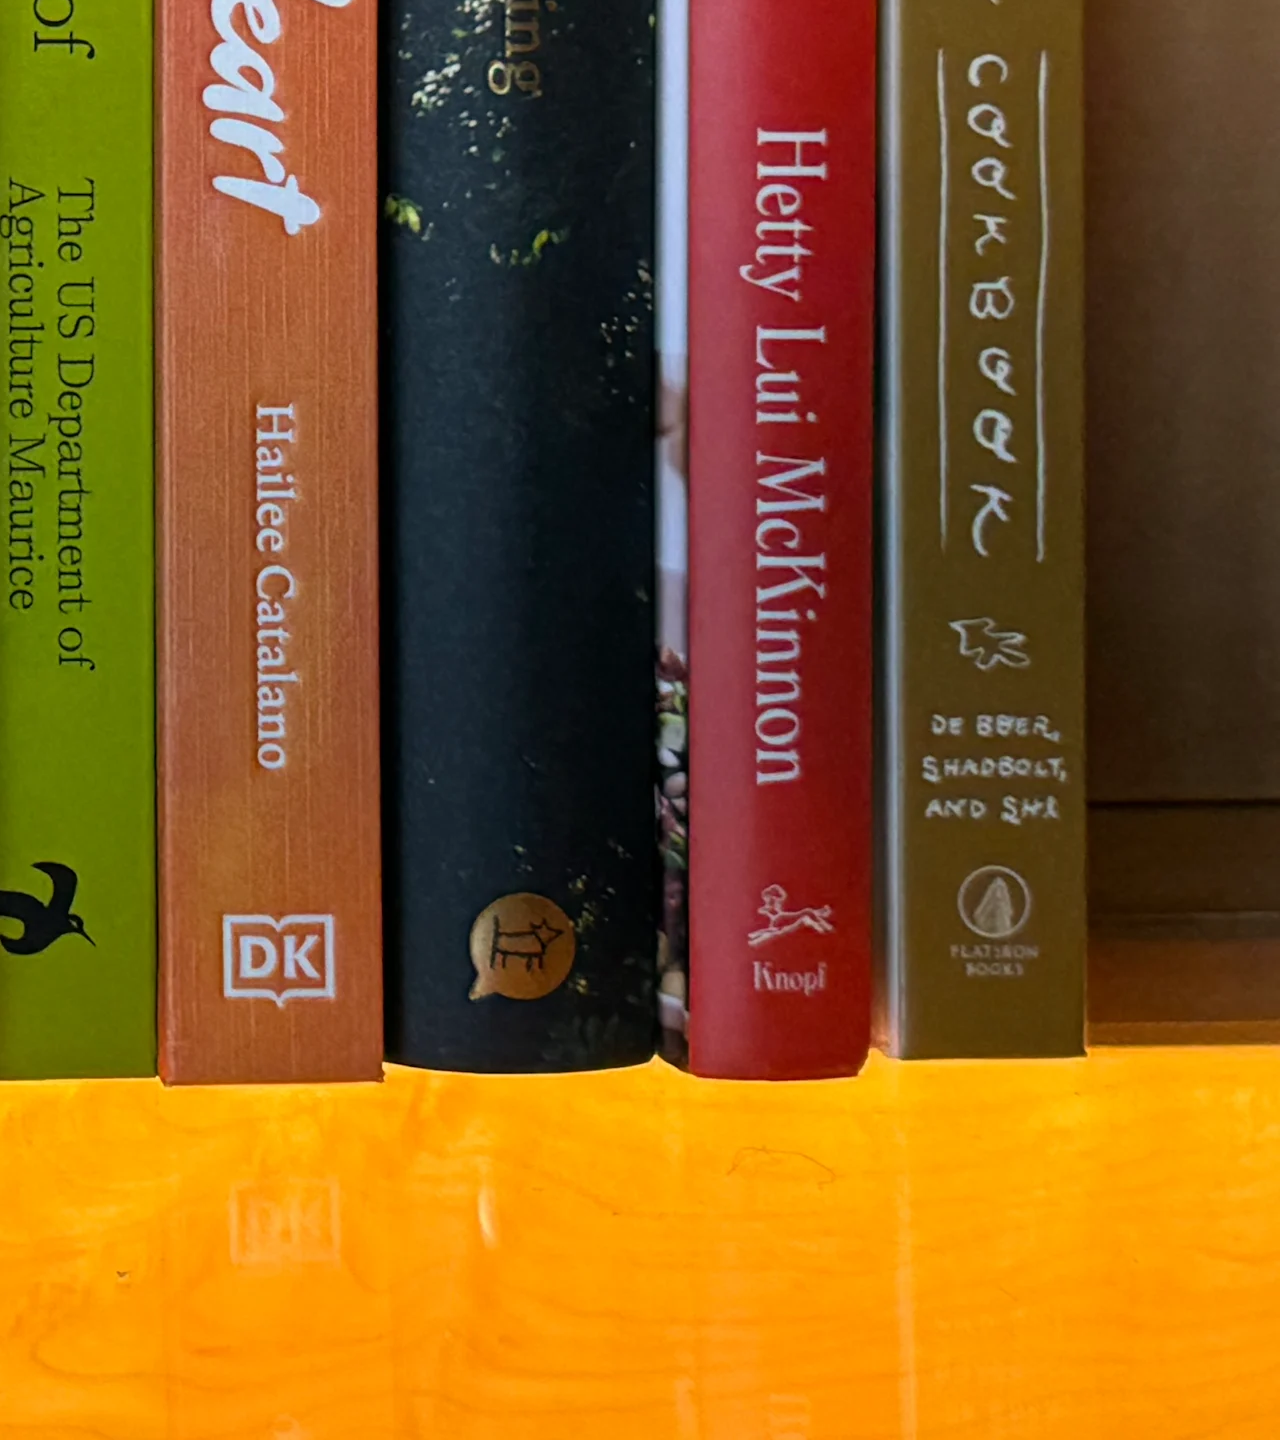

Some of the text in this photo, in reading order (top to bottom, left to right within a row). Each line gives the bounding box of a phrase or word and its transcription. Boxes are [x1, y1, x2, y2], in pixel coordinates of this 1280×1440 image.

[48, 177, 95, 671] The US Department of
[740, 127, 827, 785] Hetty Lui McKinnon
[7, 433, 45, 611] Maurice
[256, 403, 297, 770] Hailee Catalano
[931, 714, 964, 735] DE
[925, 799, 987, 820] AND
[239, 934, 320, 979] DK
[950, 945, 1039, 959] FLATIRON
[966, 963, 1023, 976] BOOKS
[753, 962, 826, 993] Knopf
